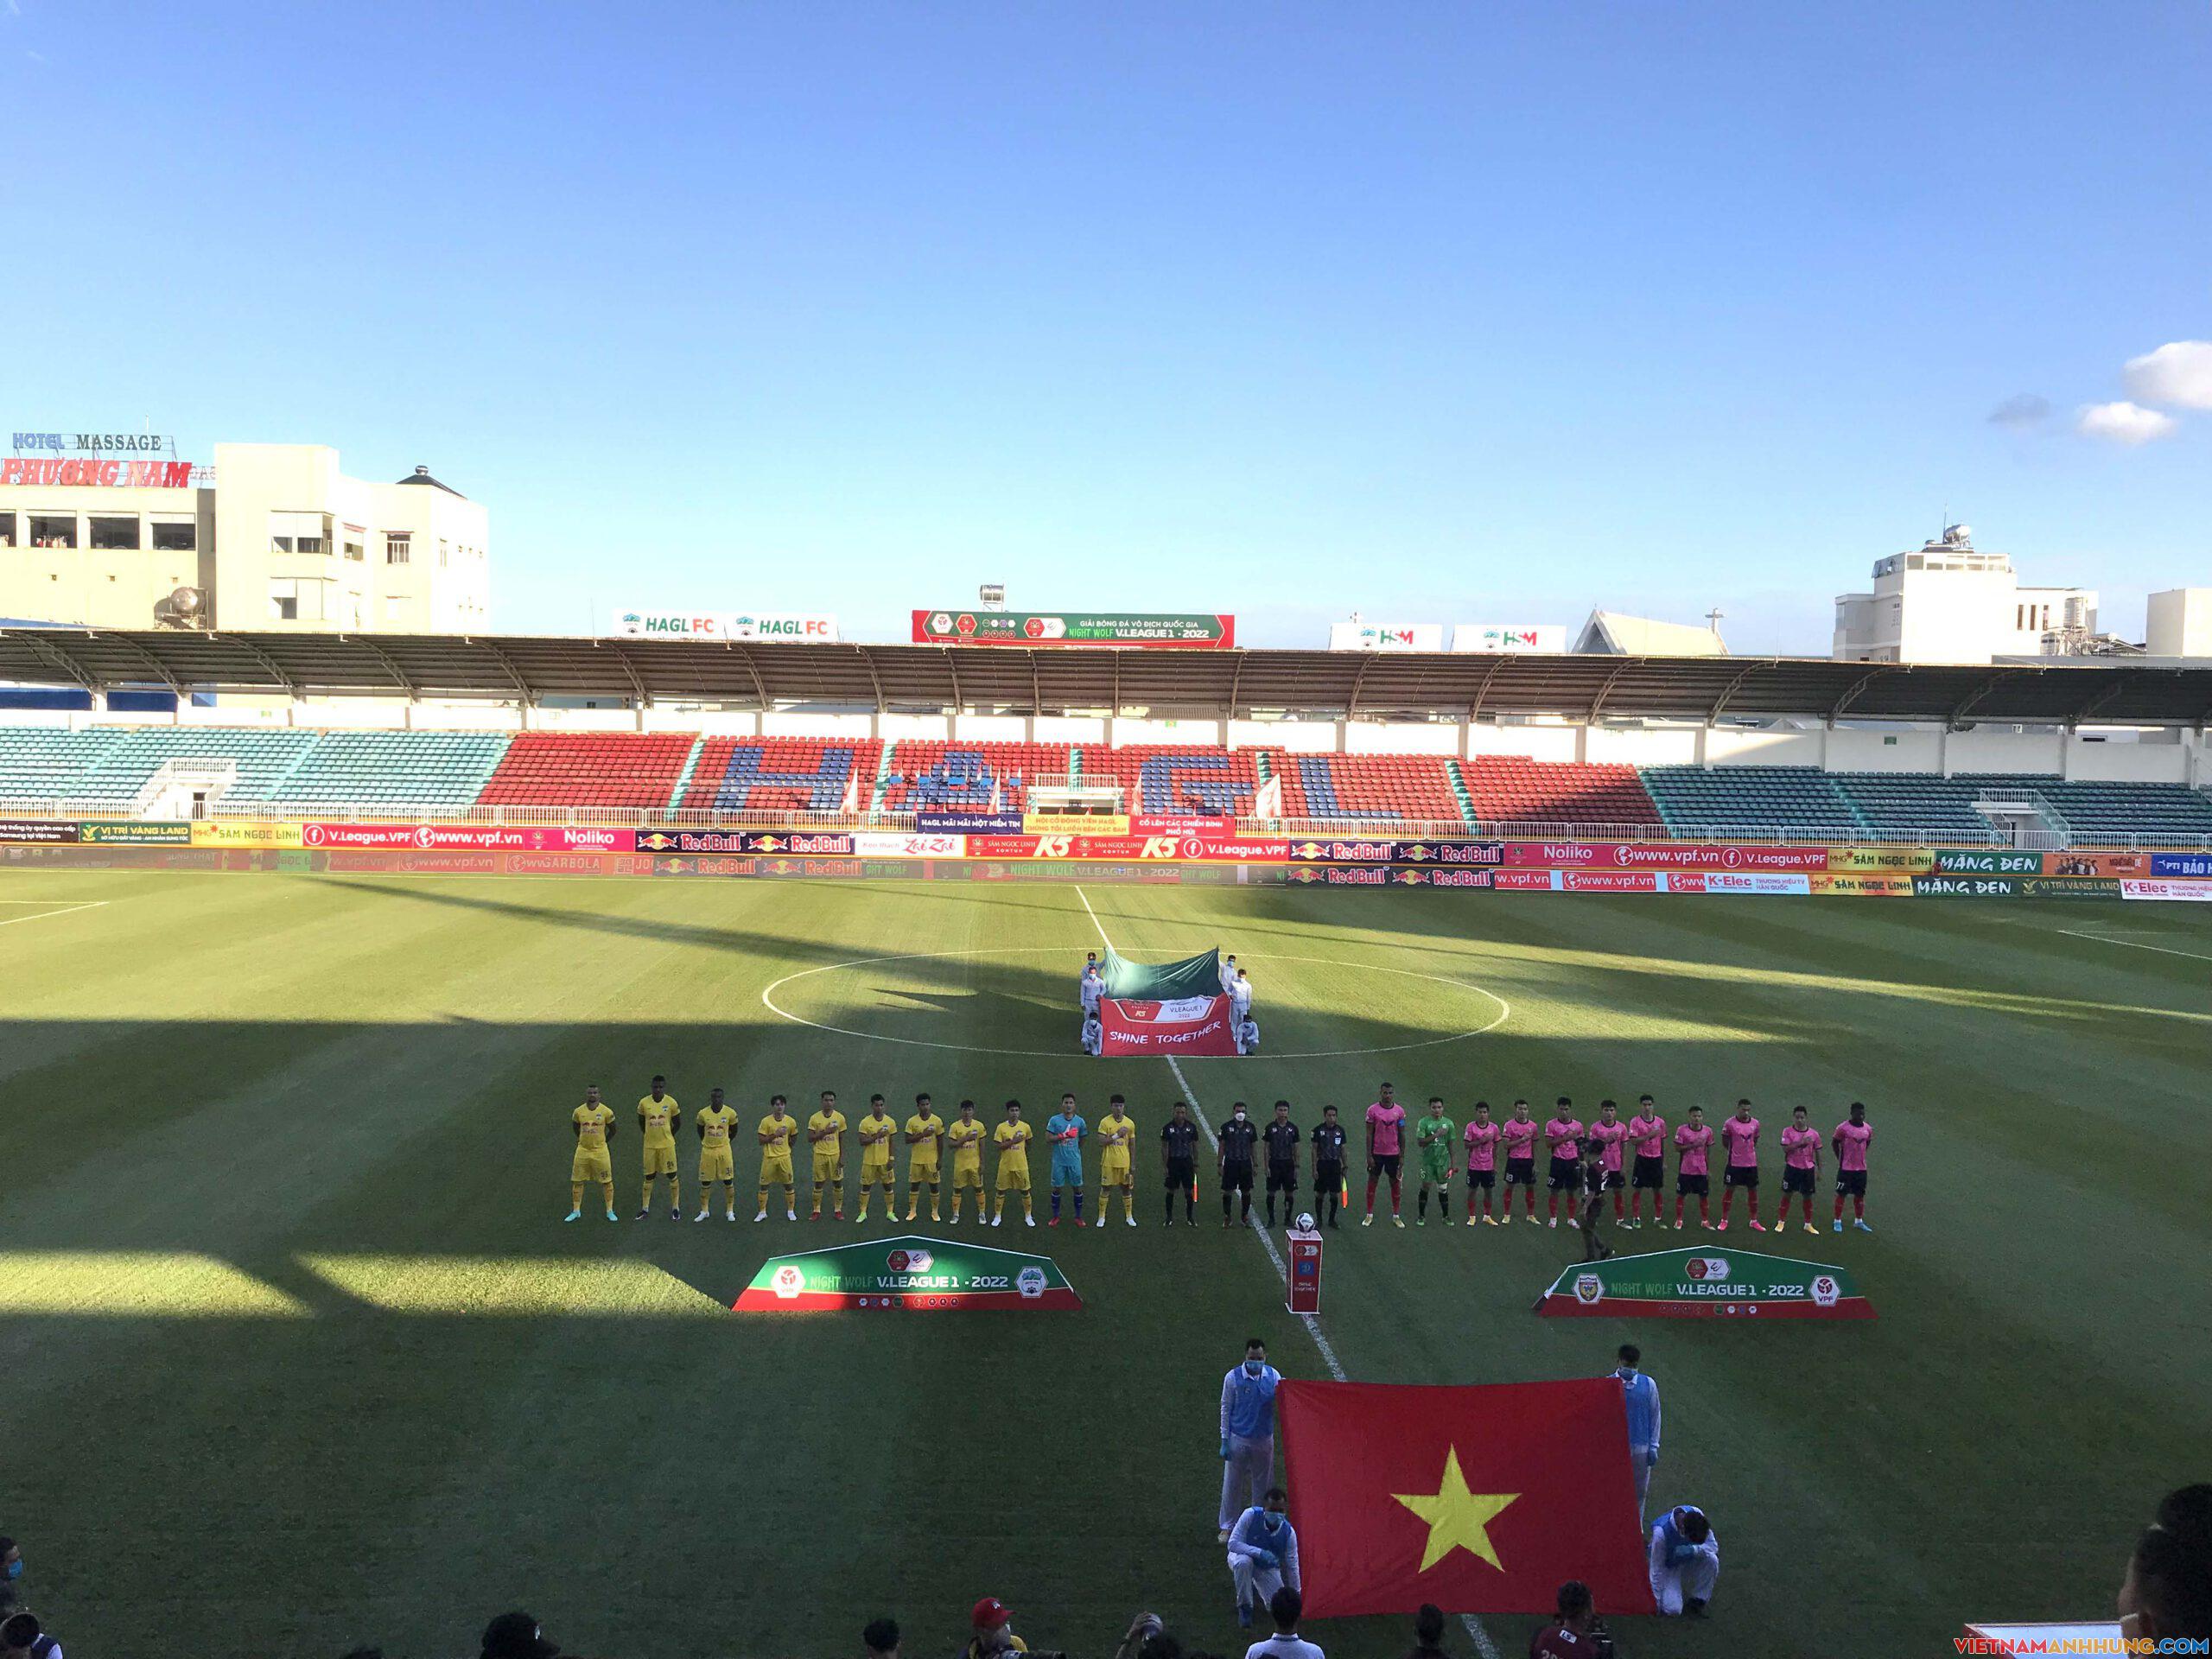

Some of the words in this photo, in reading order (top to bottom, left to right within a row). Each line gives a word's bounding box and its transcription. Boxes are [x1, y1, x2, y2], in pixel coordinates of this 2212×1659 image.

[13, 433, 65, 449] HOTEL
[76, 435, 162, 451] MASSAGE
[124, 461, 193, 488] NAM
[645, 617, 690, 632] HAGL
[693, 619, 715, 632] FC
[760, 620, 804, 634] HAGL
[805, 620, 828, 635] FC
[1069, 628, 1090, 639] NIGHT
[1093, 629, 1113, 639] WOLF
[1116, 629, 1166, 638] V.LEAGUE
[1182, 630, 1210, 639] 2022
[161, 827, 188, 836] LAND
[435, 831, 523, 847] www.vpf.vn
[563, 830, 614, 844] Noliko
[1033, 836, 1074, 857] K5
[1140, 837, 1180, 858] K5
[1543, 845, 1592, 860] Noliko
[1632, 849, 1719, 865] www.vpf.vn
[1909, 855, 1932, 866] LINH
[1999, 857, 2038, 872] ĐEN
[1152, 868, 1179, 878] 2022
[2183, 858, 2204, 874] BẢO
[1581, 875, 1655, 888] www.vpf.vn
[1707, 875, 1752, 887] K-Elec
[1975, 880, 2012, 894] ĐEN
[2123, 881, 2169, 893] K-Elec
[1109, 1031, 1148, 1044] SHINE
[1155, 1020, 1221, 1044] TOGETHER
[810, 1275, 842, 1288] NIGHT
[844, 1276, 874, 1287] WOLF
[876, 1276, 950, 1287] V.LEAGUE
[971, 1276, 1009, 1287] 2022
[1611, 1282, 1642, 1295] NIGHT
[1645, 1282, 1674, 1295] WOLF
[1676, 1284, 1746, 1296] V.LEAGUE
[1768, 1285, 1804, 1296] 2022
